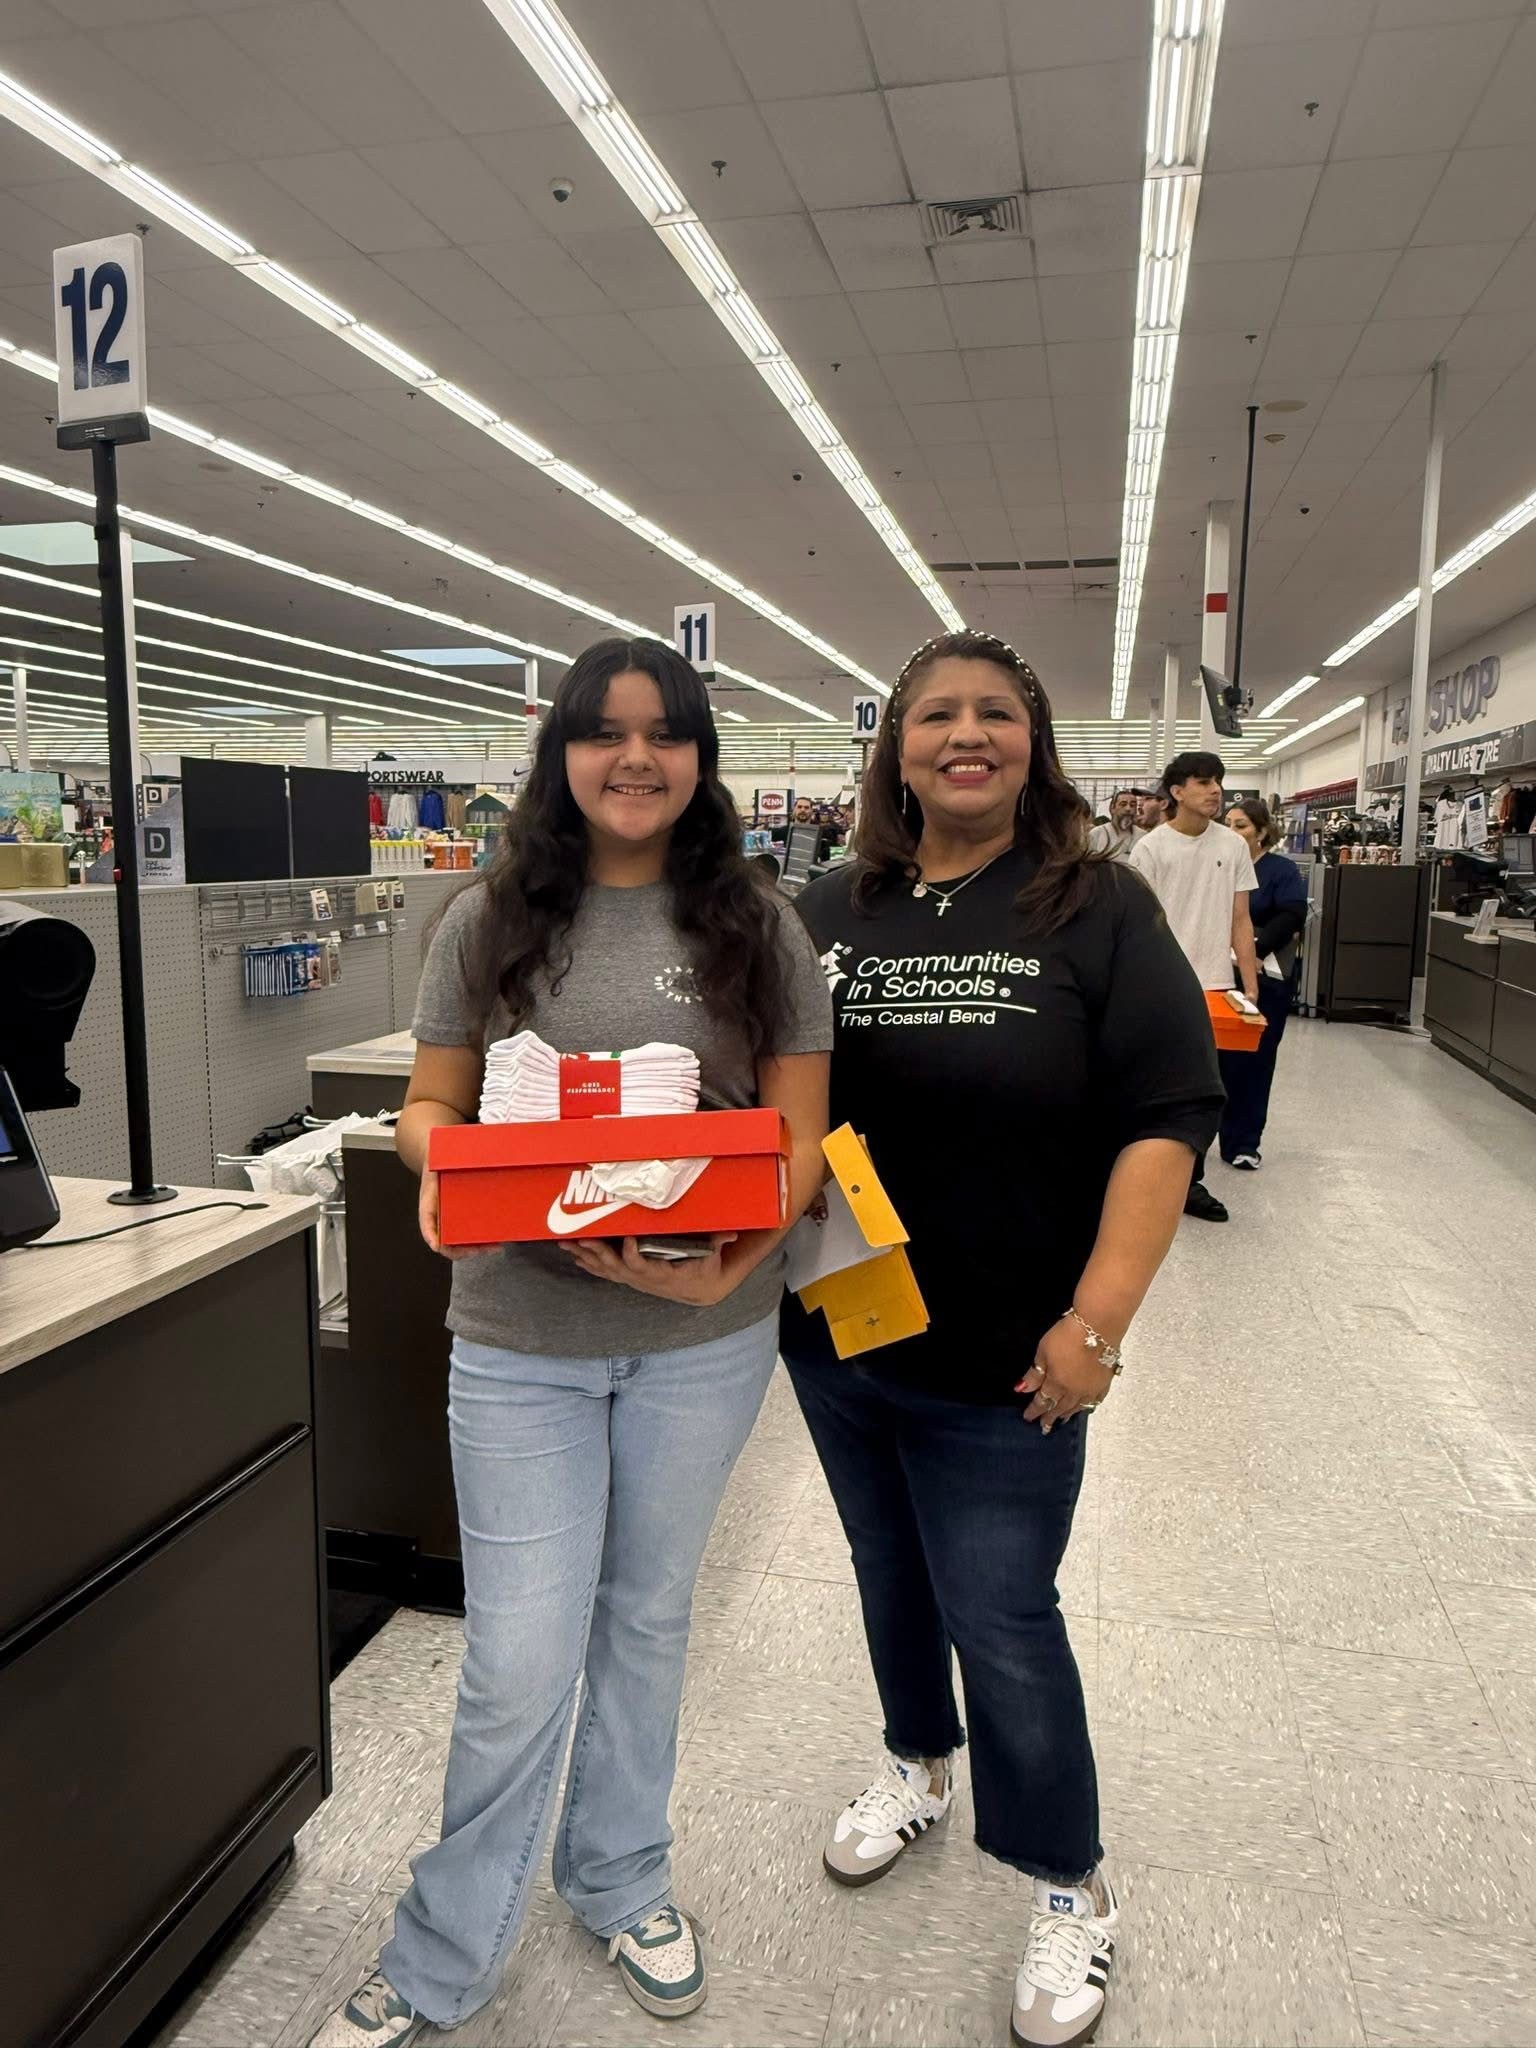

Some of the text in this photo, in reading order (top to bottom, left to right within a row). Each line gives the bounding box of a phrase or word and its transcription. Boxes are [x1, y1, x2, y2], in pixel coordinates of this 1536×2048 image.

[61, 262, 130, 390] 12
[680, 613, 707, 661] 11
[1429, 655, 1499, 734] SHOP
[855, 702, 877, 730] 10
[1476, 749, 1485, 770] 7
[368, 770, 445, 783] ORTSWEAR
[150, 832, 166, 853] D
[856, 950, 1041, 977] Communities
[846, 980, 872, 1000] In
[839, 1009, 996, 1028] The Coastal Bend
